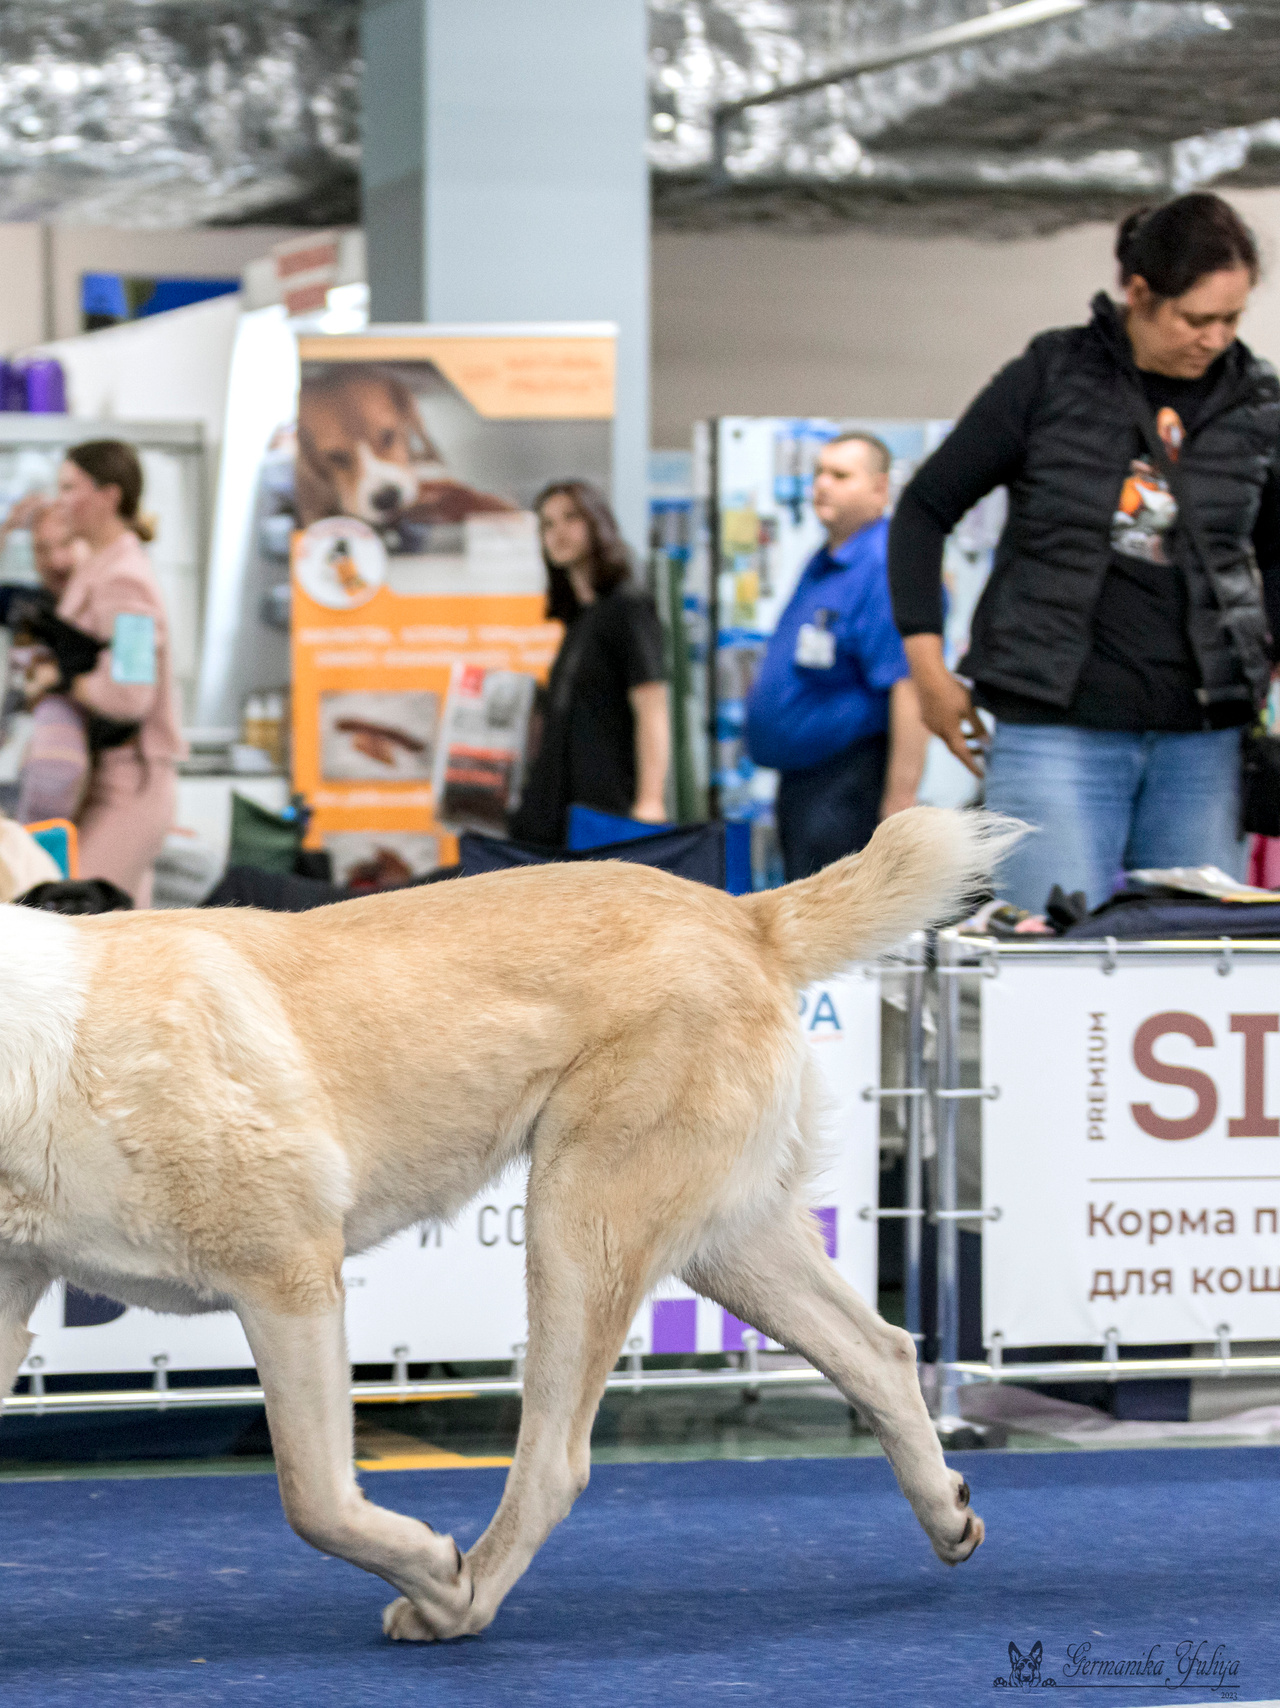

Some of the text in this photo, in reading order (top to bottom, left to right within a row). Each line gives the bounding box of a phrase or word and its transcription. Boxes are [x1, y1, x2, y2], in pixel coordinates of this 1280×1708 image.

[1087, 1012, 1108, 1141] PREMIUM
[1087, 1201, 1237, 1246] Корма
[1087, 1269, 1174, 1302] для
